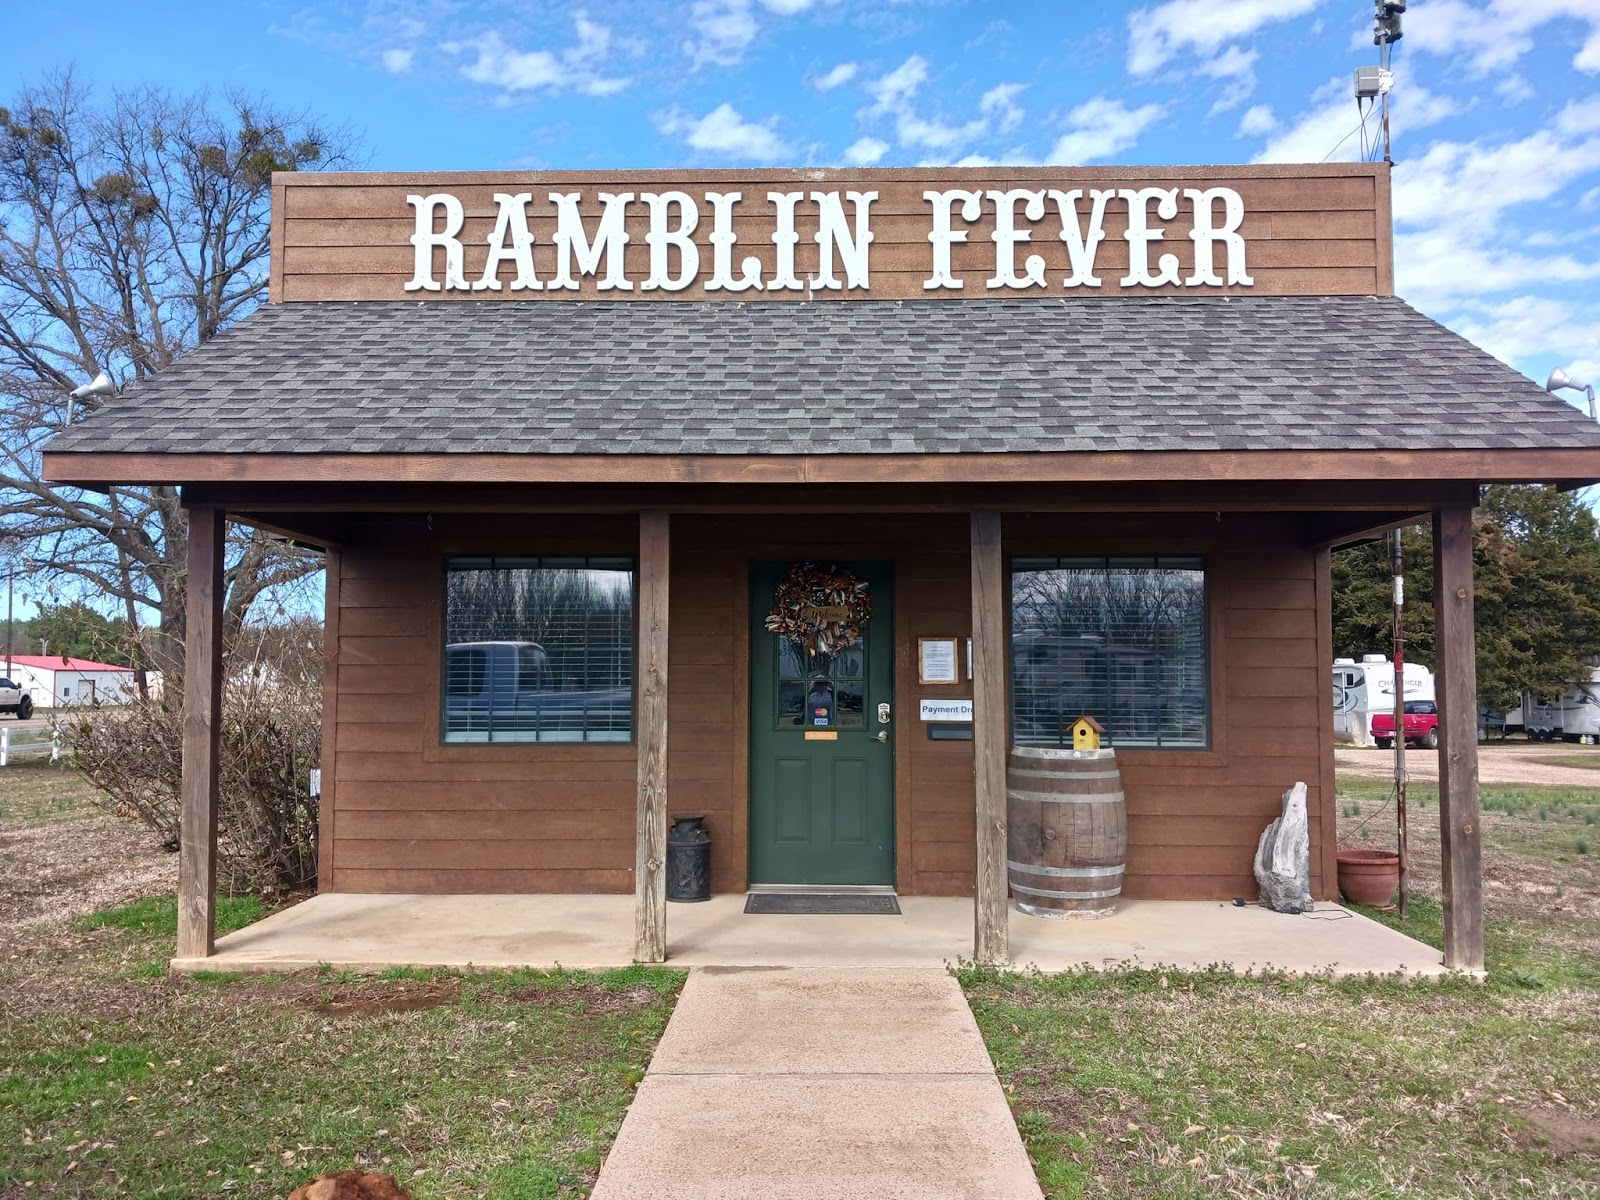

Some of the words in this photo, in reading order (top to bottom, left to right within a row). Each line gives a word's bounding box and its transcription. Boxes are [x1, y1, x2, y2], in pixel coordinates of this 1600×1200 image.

[404, 190, 879, 292] RAMBLIN
[923, 187, 1254, 290] FEVER
[922, 705, 959, 715] Payment
